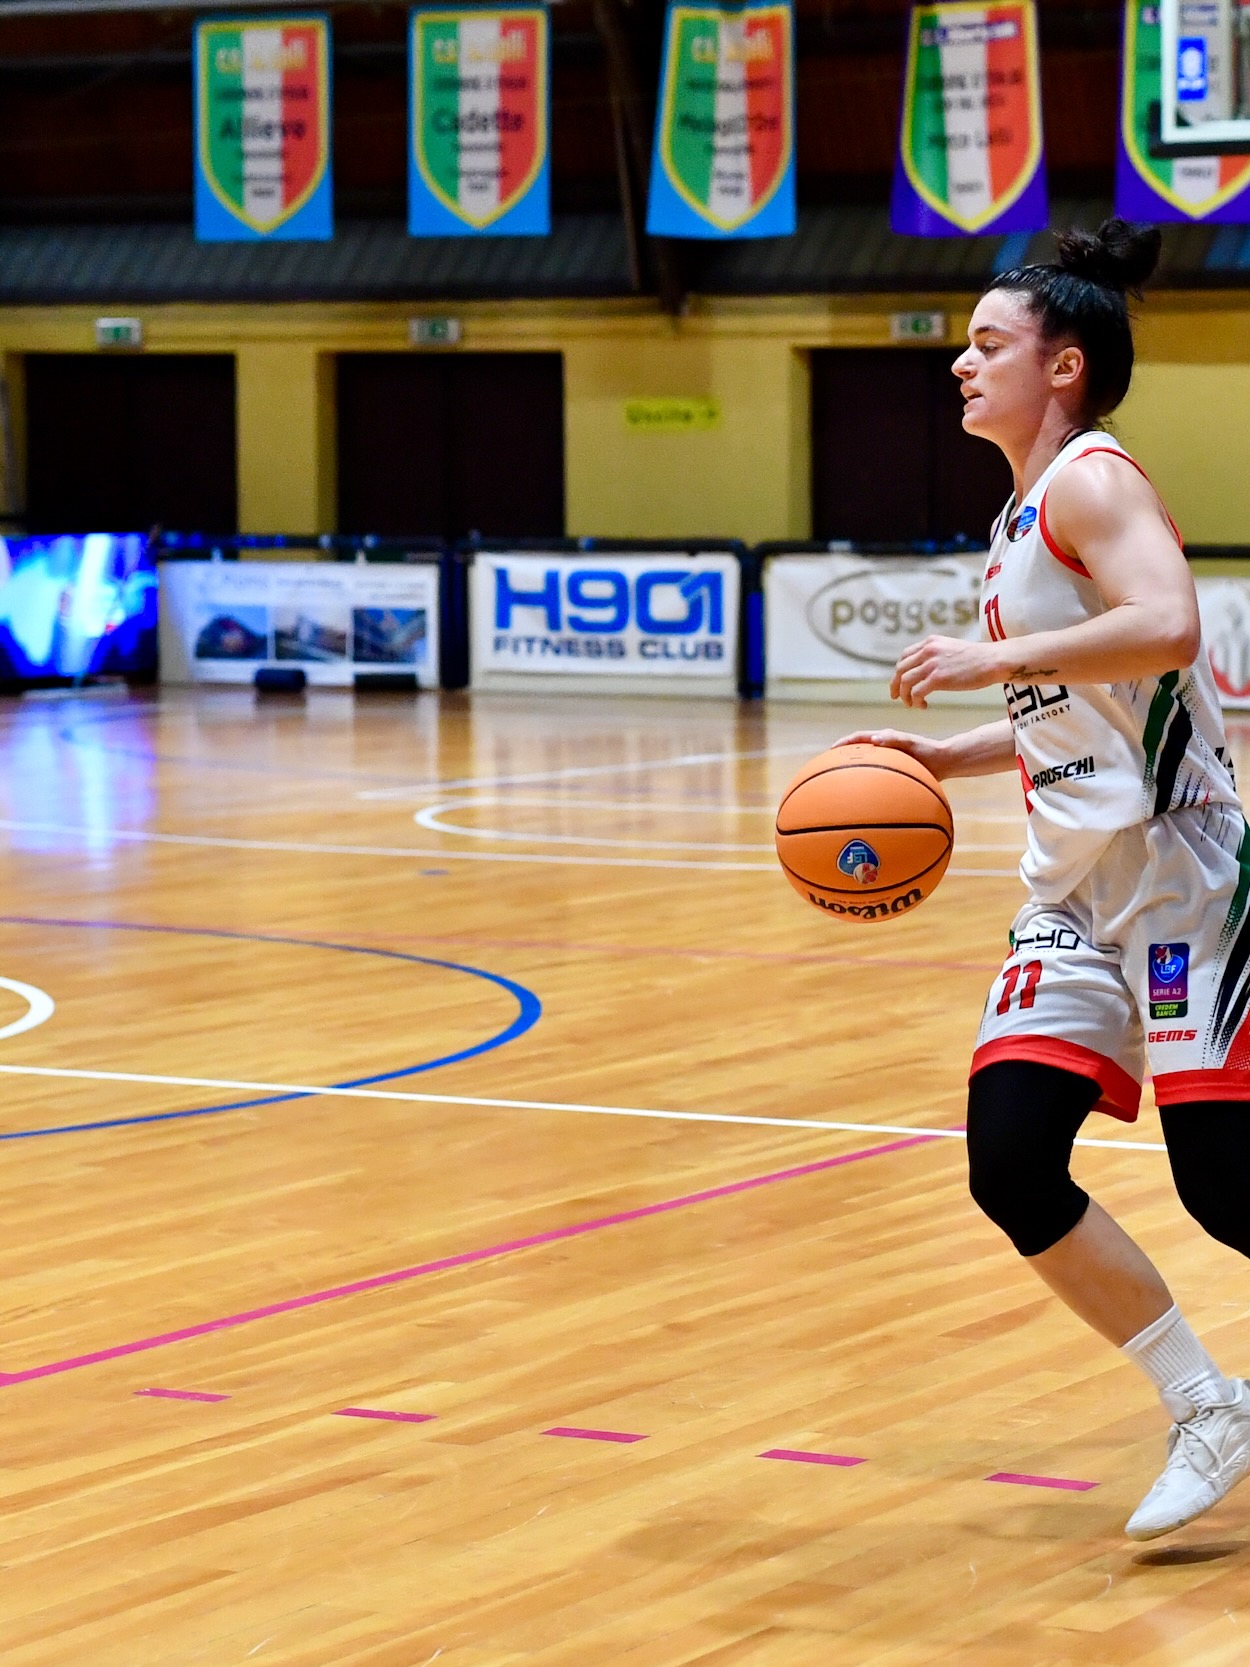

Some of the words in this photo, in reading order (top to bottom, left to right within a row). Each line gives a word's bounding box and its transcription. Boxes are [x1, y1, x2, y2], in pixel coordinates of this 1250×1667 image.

[495, 568, 724, 635] H901
[494, 636, 626, 659] FITNESS
[638, 639, 724, 661] CLUB
[1031, 704, 1072, 724] FACTORY
[1032, 756, 1095, 791] BRUSCHI
[1160, 964, 1177, 975] LBF
[996, 960, 1043, 1016] 11
[1153, 988, 1170, 997] SERIE
[1172, 987, 1182, 996] A2
[1155, 1003, 1179, 1011] CREDEM
[1156, 1010, 1177, 1018] BANCA
[1148, 1029, 1198, 1043] GEMS
